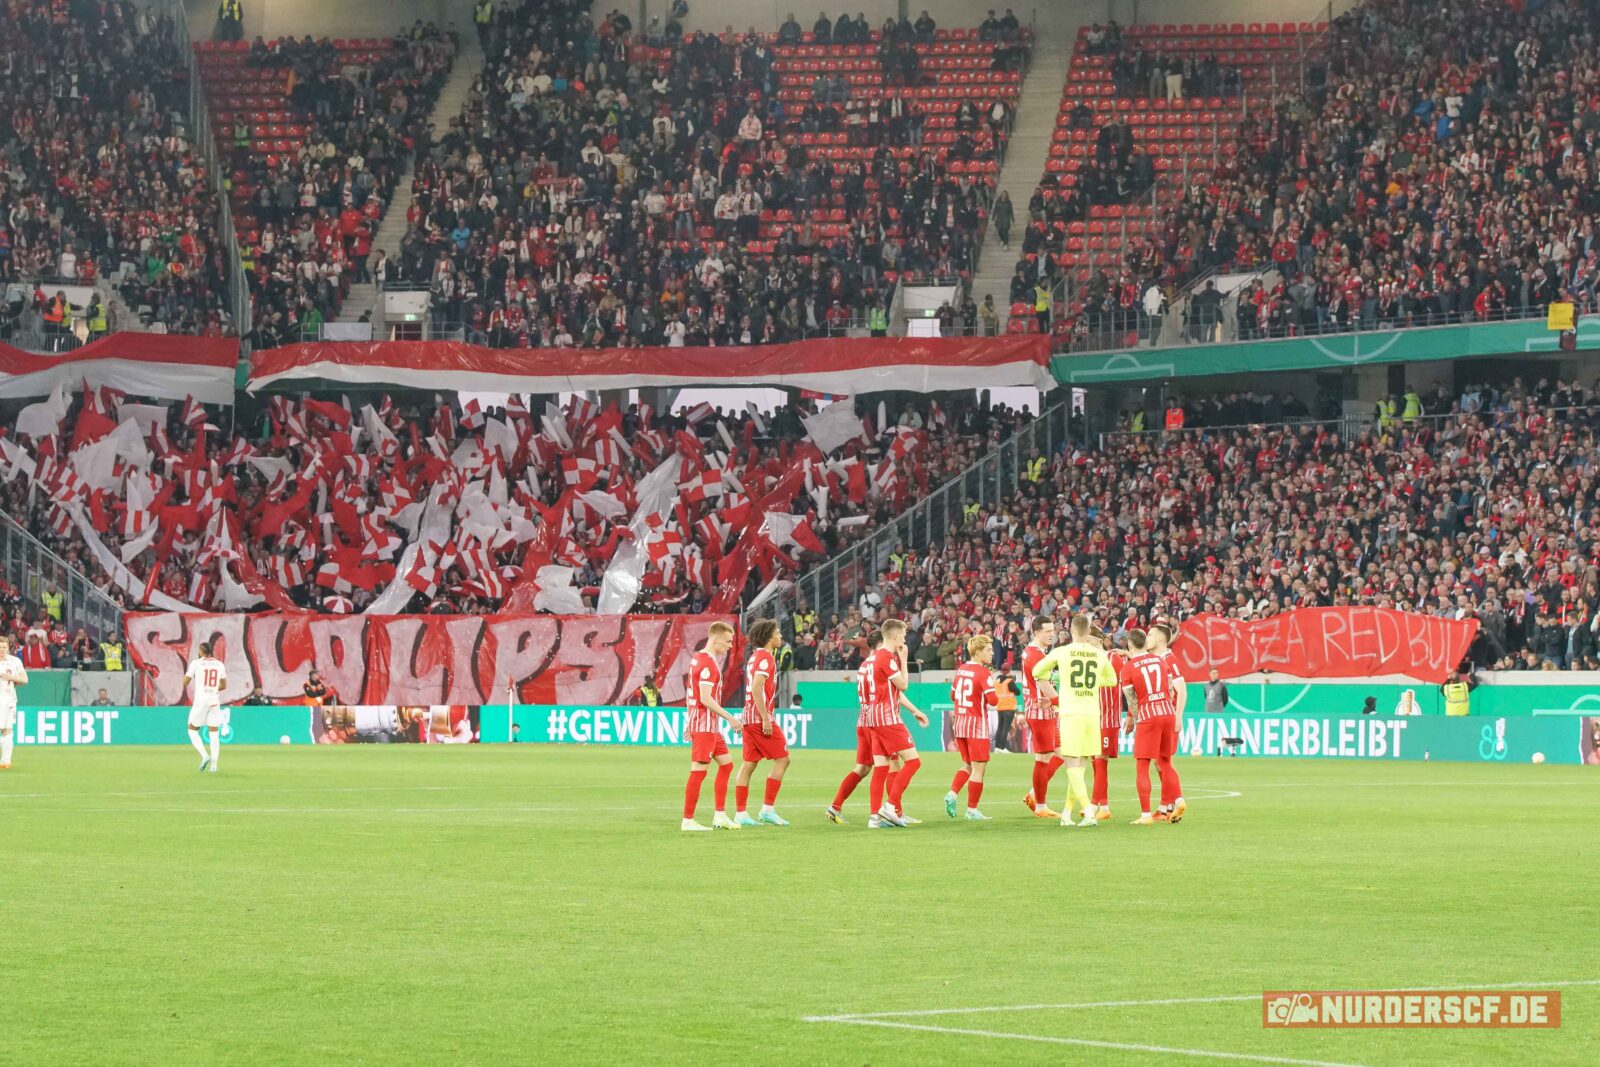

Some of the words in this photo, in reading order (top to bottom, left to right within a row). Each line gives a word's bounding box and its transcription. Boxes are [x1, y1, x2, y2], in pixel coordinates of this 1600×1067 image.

[1182, 613, 1306, 670] SENZA
[1321, 608, 1399, 663] RED
[204, 669, 218, 687] 18
[1070, 660, 1098, 689] 26
[1140, 664, 1161, 695] 17
[954, 678, 974, 708] 42
[1104, 737, 1109, 748] 9
